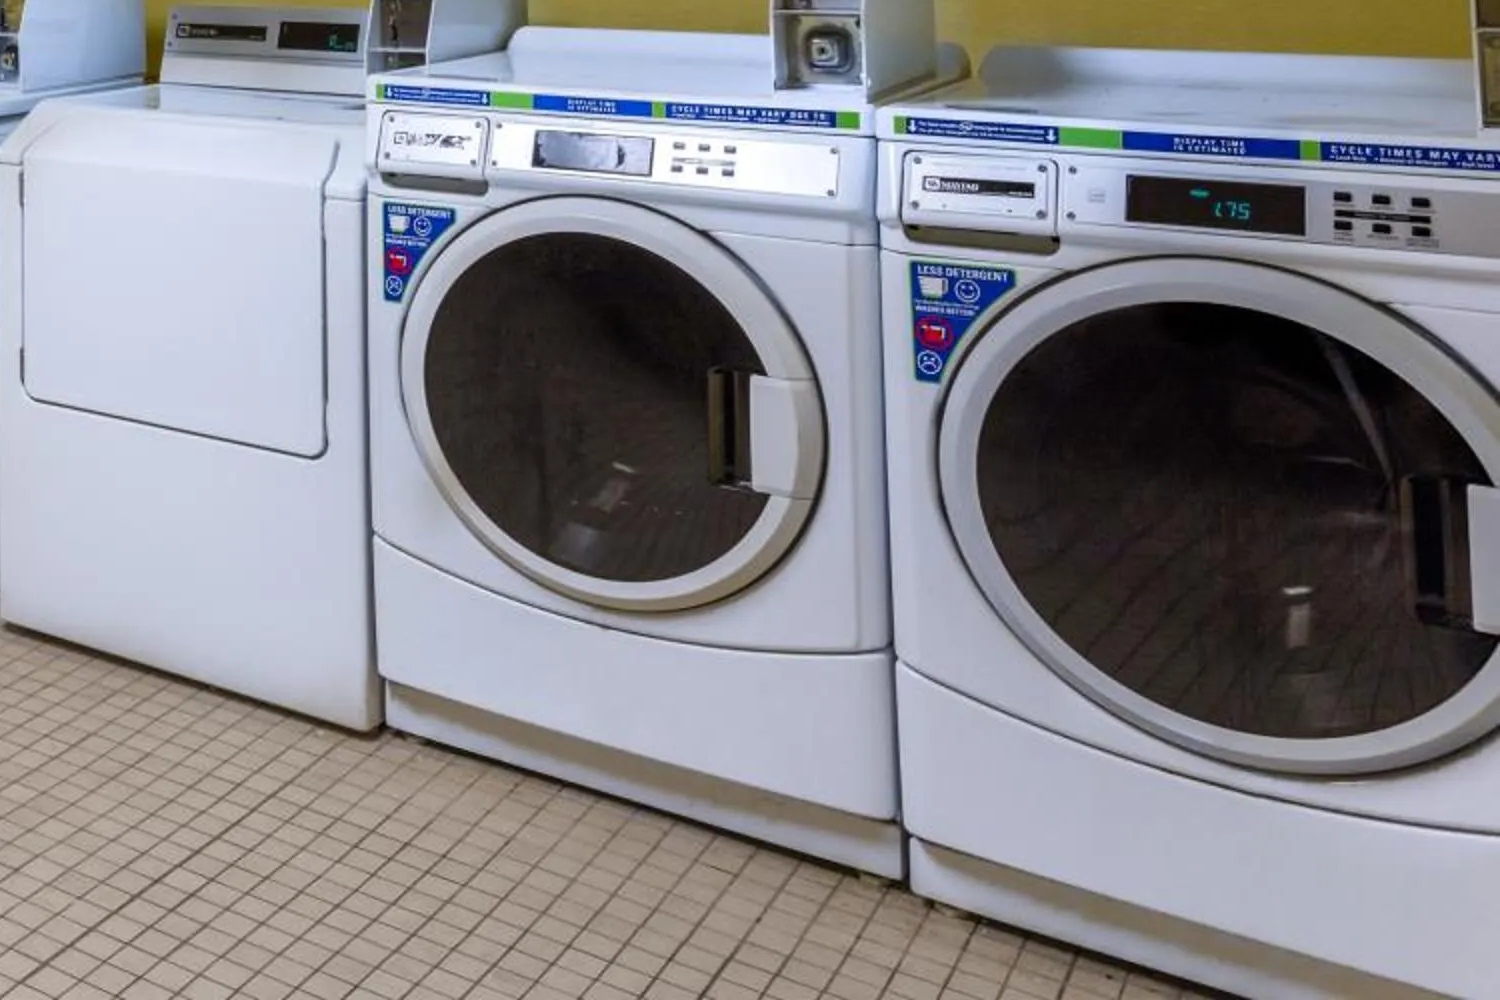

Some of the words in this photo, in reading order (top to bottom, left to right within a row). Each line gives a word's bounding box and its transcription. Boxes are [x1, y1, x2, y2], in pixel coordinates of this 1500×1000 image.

[1331, 145, 1373, 156] CYCLE
[1379, 147, 1424, 159] TIMES
[1429, 150, 1460, 160] MAY
[917, 265, 944, 276] LESS
[945, 268, 1009, 283] DETERGENT
